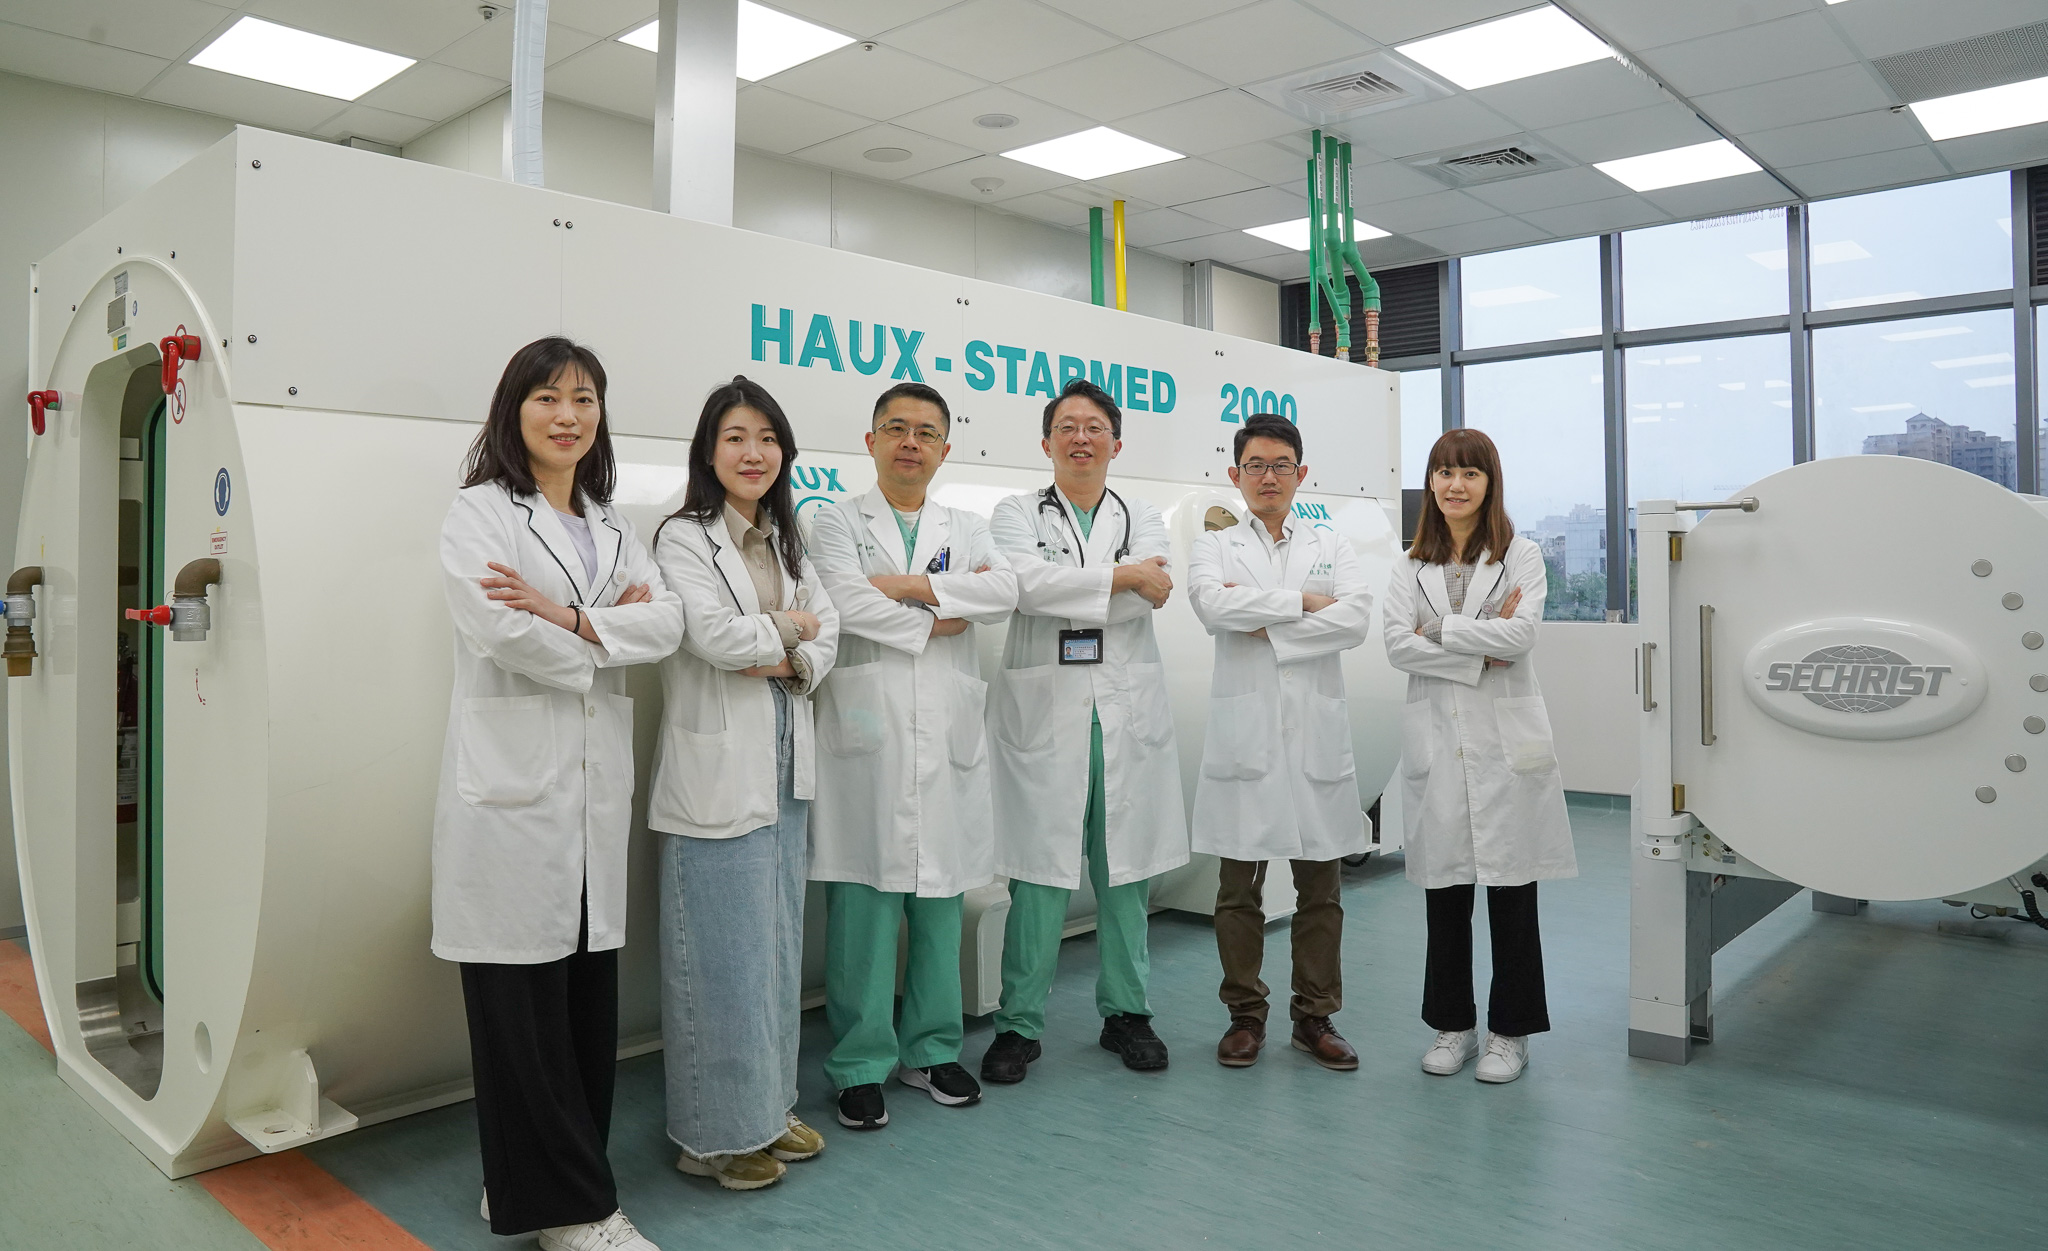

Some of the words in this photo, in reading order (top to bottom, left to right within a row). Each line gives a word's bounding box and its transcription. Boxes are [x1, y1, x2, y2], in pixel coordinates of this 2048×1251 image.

[1220, 383, 1297, 426] 2000
[790, 465, 848, 492] UX
[1765, 663, 1952, 696] SECHRIST
